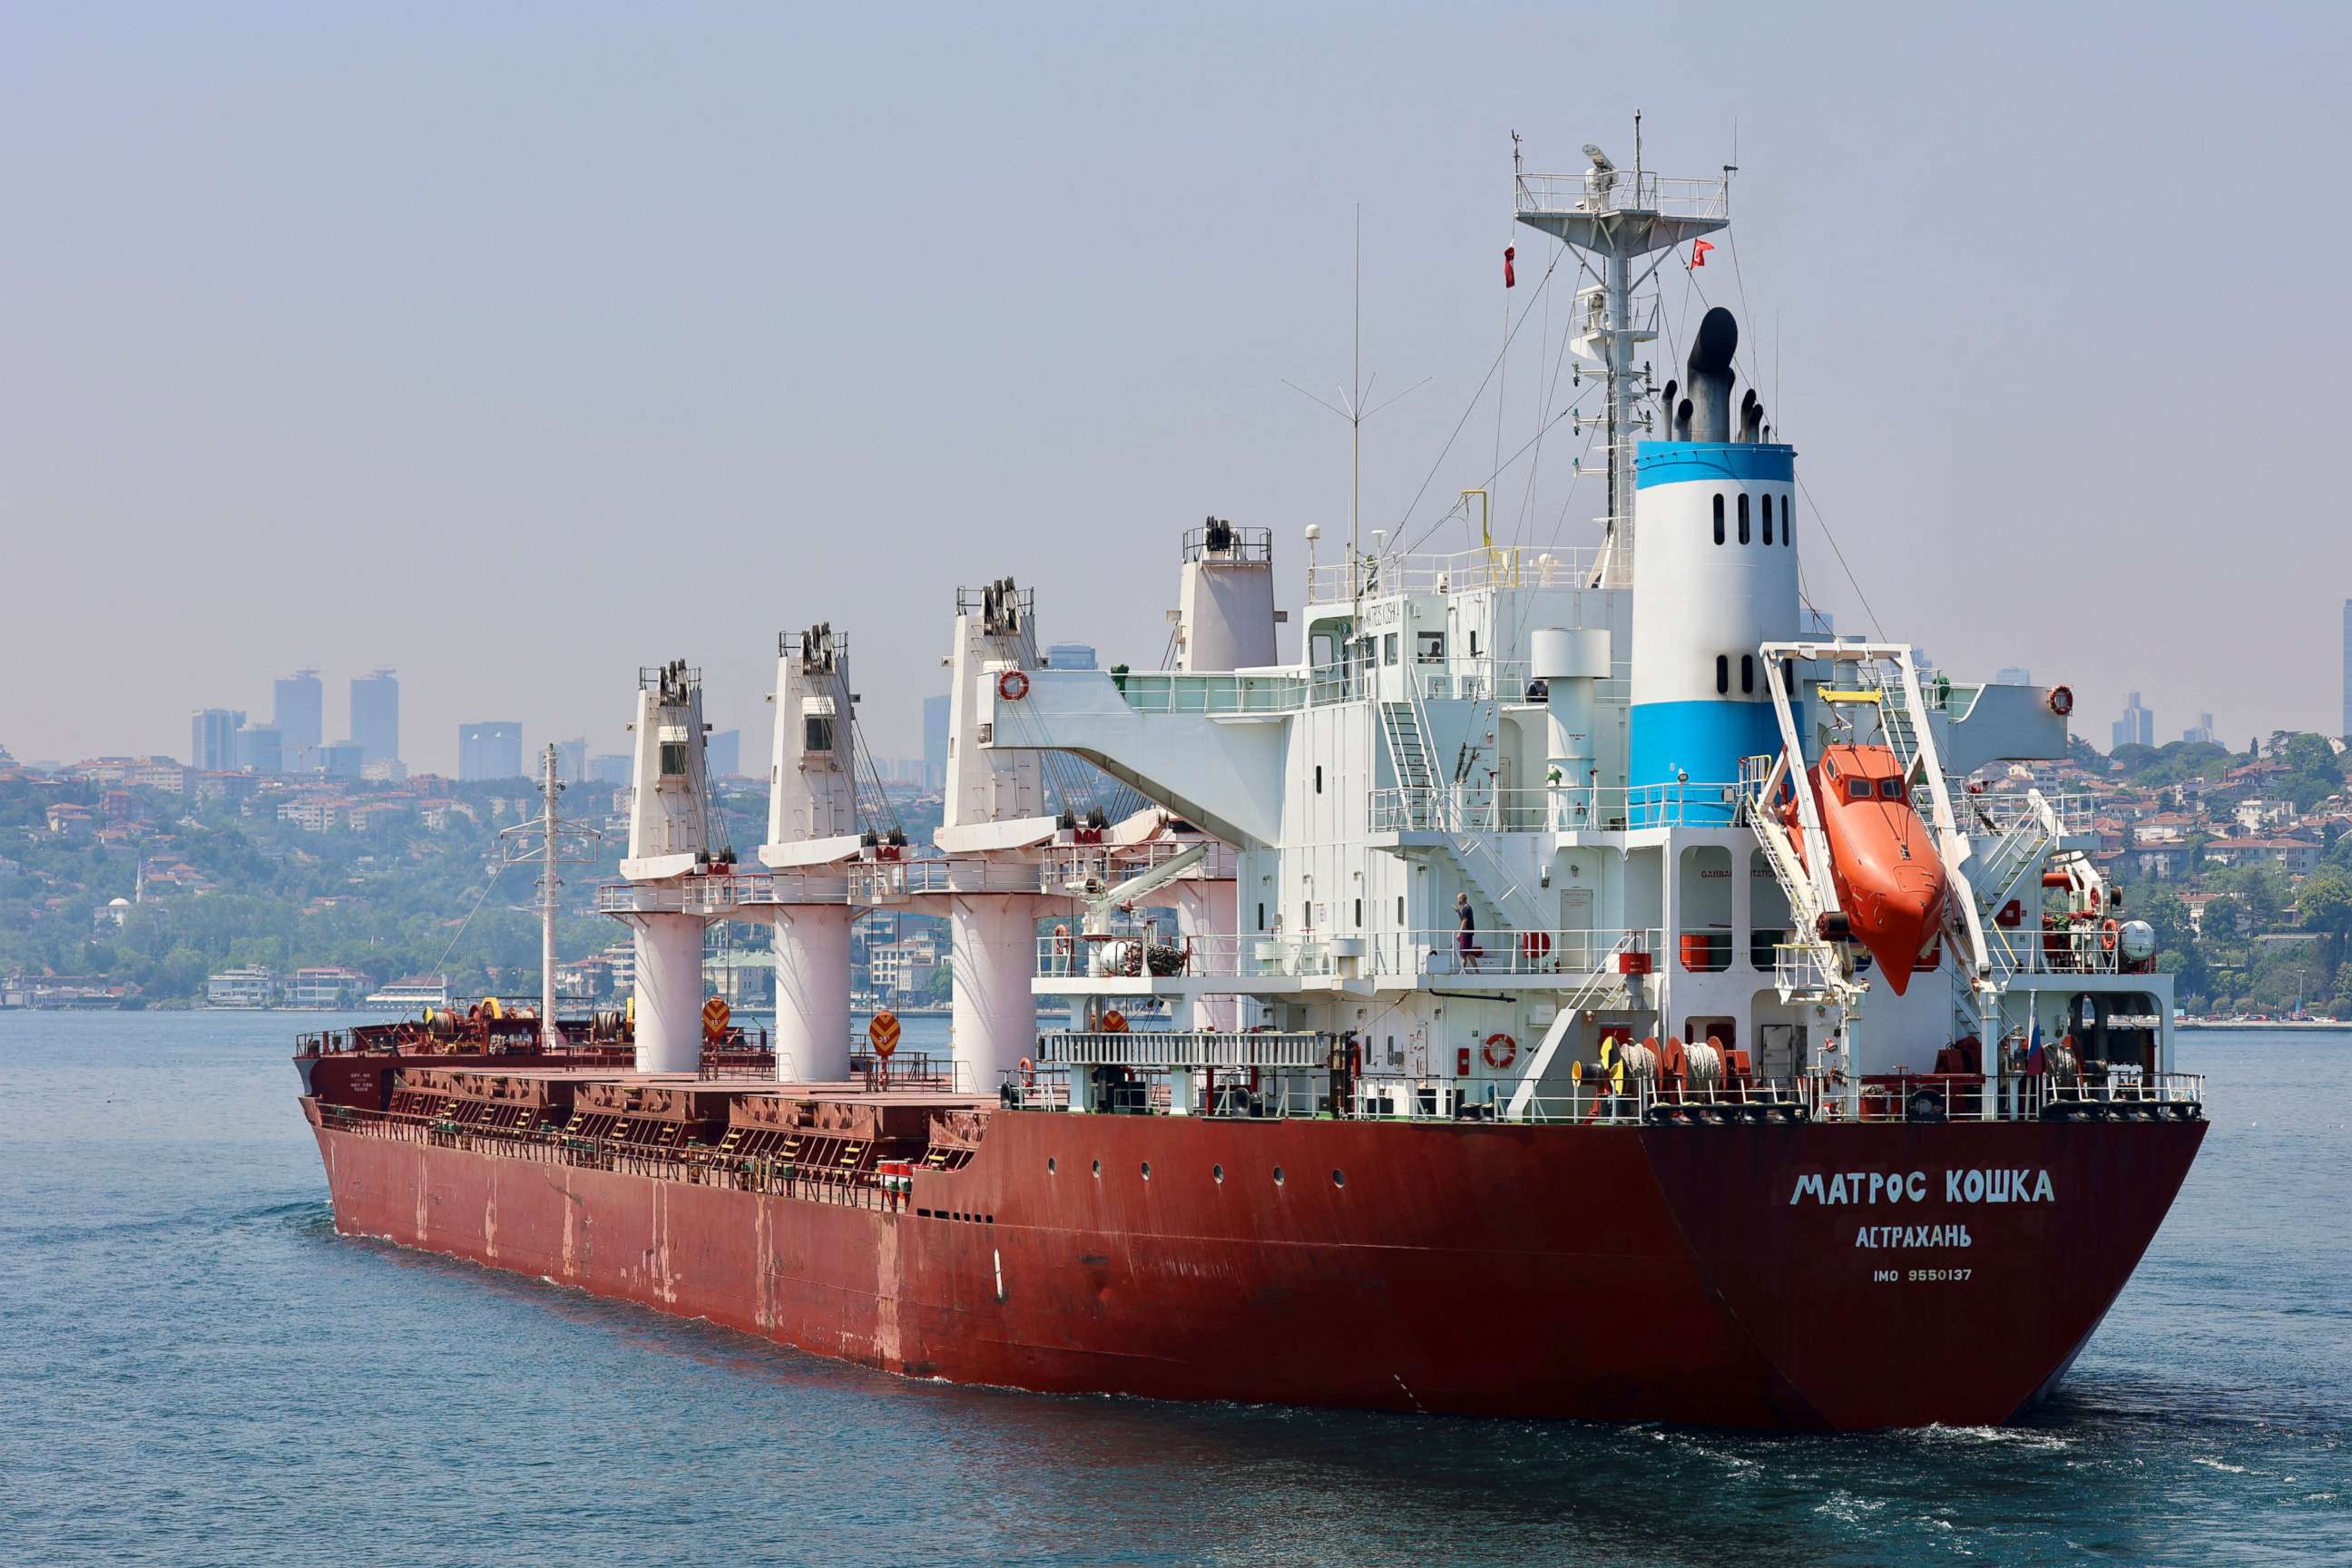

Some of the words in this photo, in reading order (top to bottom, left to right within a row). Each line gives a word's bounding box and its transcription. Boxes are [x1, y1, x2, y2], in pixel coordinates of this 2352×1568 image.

[1790, 1171, 1926, 1204] МАТРОС
[1946, 1170, 2054, 1202] КОШКА
[1856, 1225, 1971, 1248] АСТРАХАНЬ
[1875, 1270, 1898, 1281] IMO
[1909, 1269, 1971, 1280] 9550137
